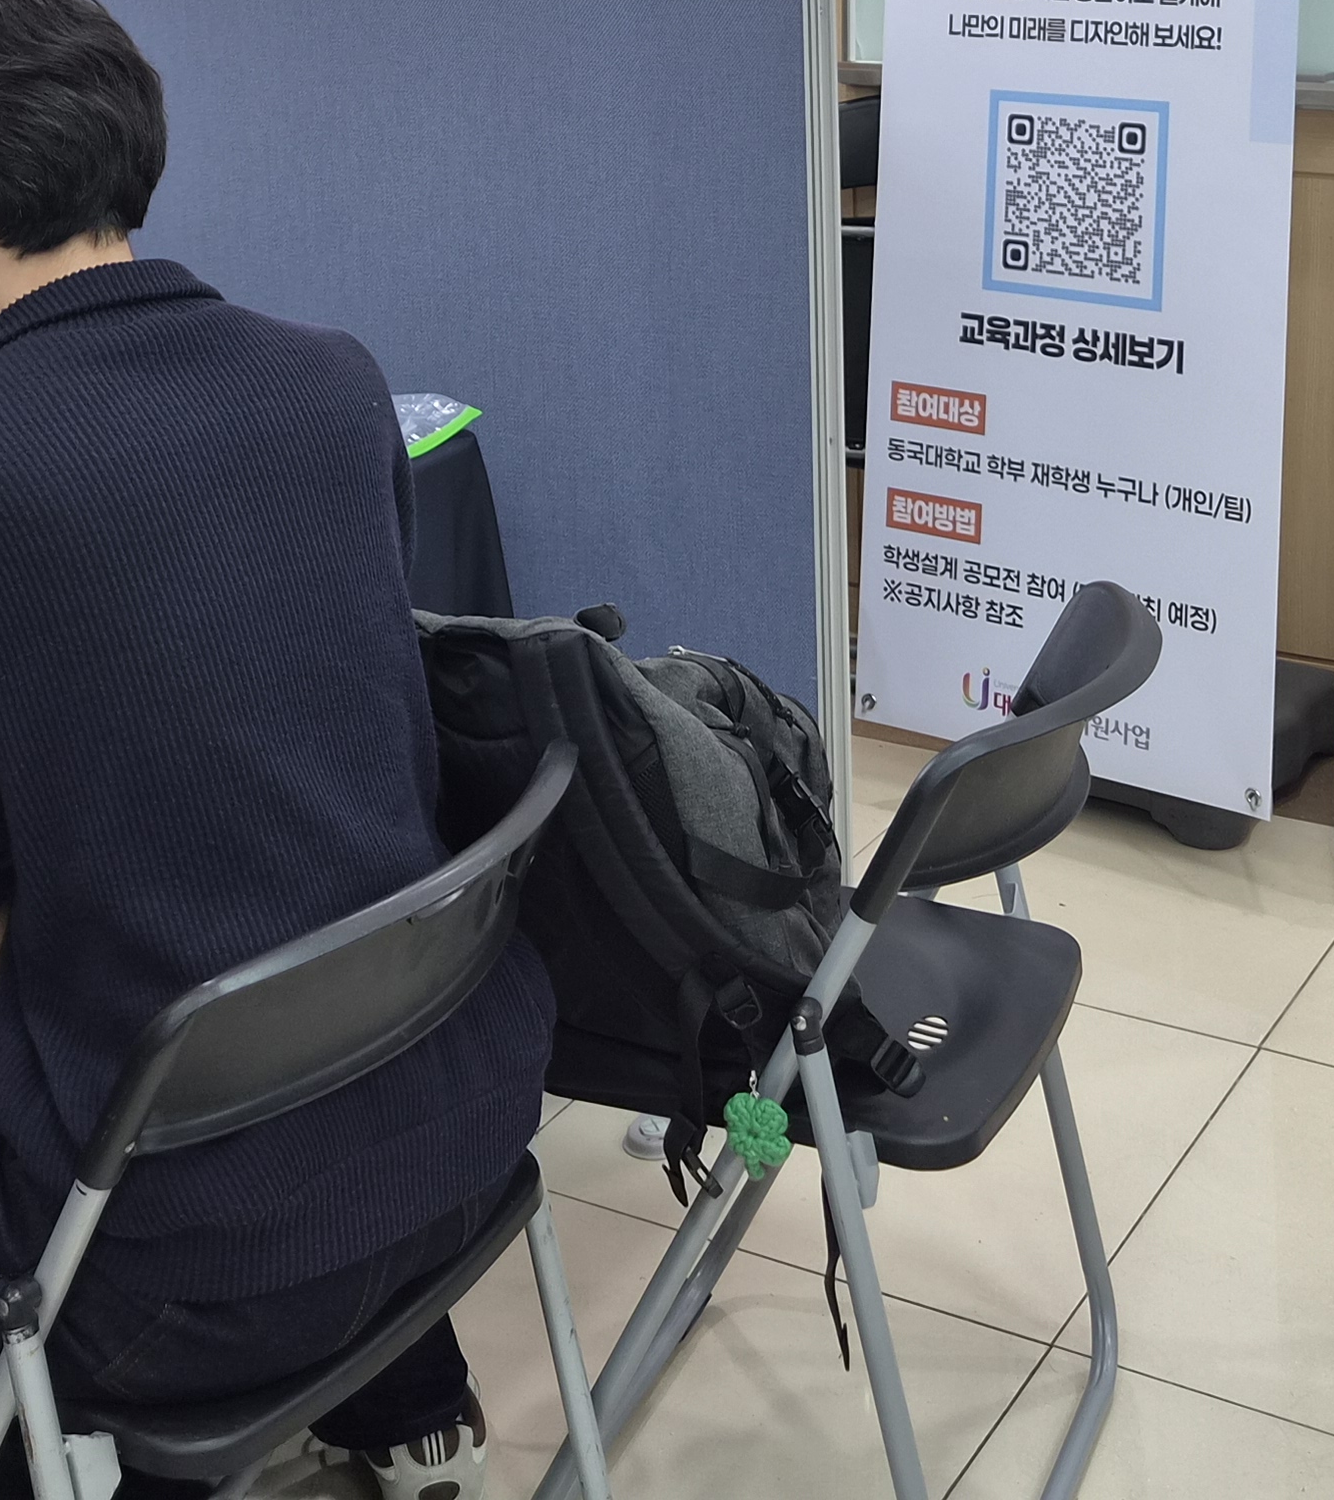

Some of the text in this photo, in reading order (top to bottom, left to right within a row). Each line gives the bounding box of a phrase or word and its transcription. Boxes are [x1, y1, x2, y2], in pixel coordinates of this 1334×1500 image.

[948, 13, 1222, 51] 나만의 미래를 디자인해 보세요!
[959, 312, 1184, 375] 교육과정 상세보기
[896, 389, 981, 427] 참여대상
[887, 437, 1252, 524] 동국대학교 학부 재학생 누구나 (개인/팀)
[892, 495, 976, 536] 참여방법
[883, 544, 958, 581] 학생설계
[963, 560, 1021, 594] 공모전
[1026, 572, 1065, 603] 참여
[1168, 601, 1217, 634] 예정)
[985, 599, 1024, 629] 참조
